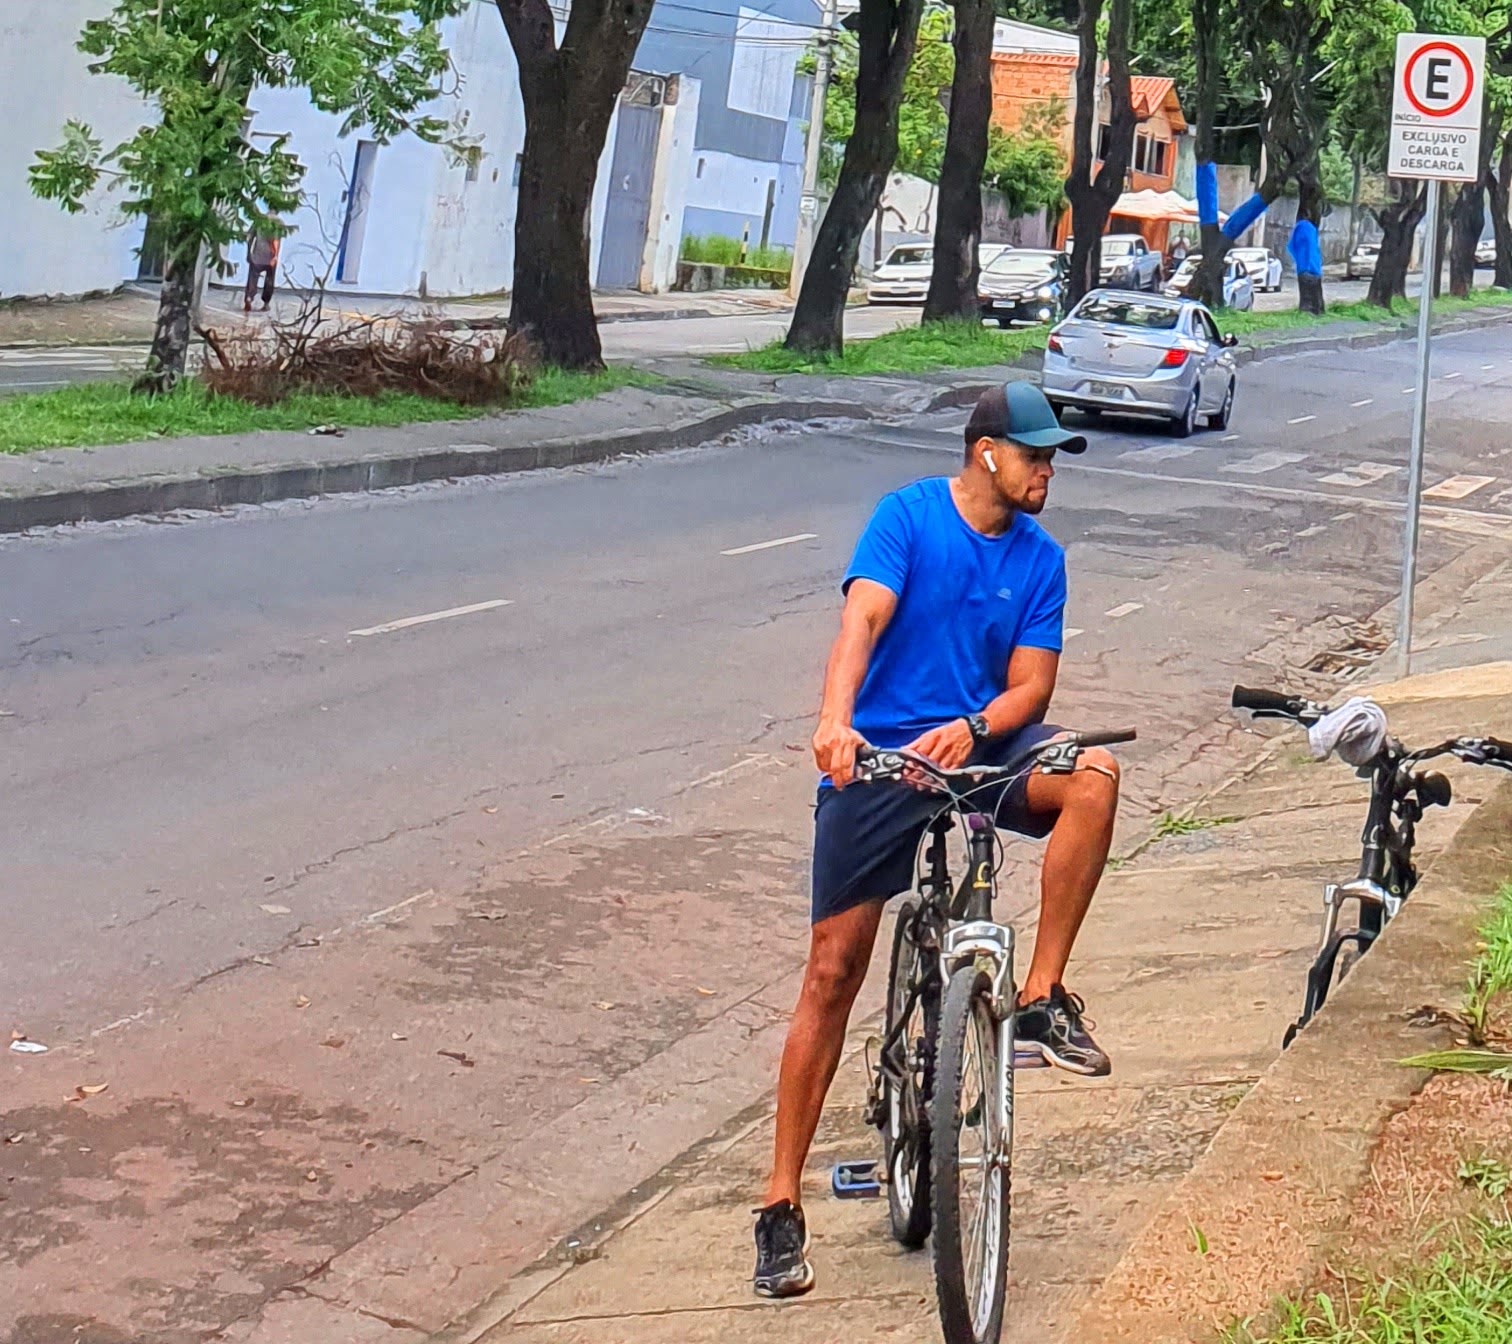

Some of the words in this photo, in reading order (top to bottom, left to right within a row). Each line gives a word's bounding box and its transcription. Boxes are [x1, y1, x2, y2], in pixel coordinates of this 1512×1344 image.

[1426, 58, 1452, 100] E
[1402, 131, 1467, 145] EXCLUSIVO
[1408, 145, 1449, 157] CARGA
[1452, 147, 1460, 158] E
[1400, 158, 1464, 172] DESCARGA
